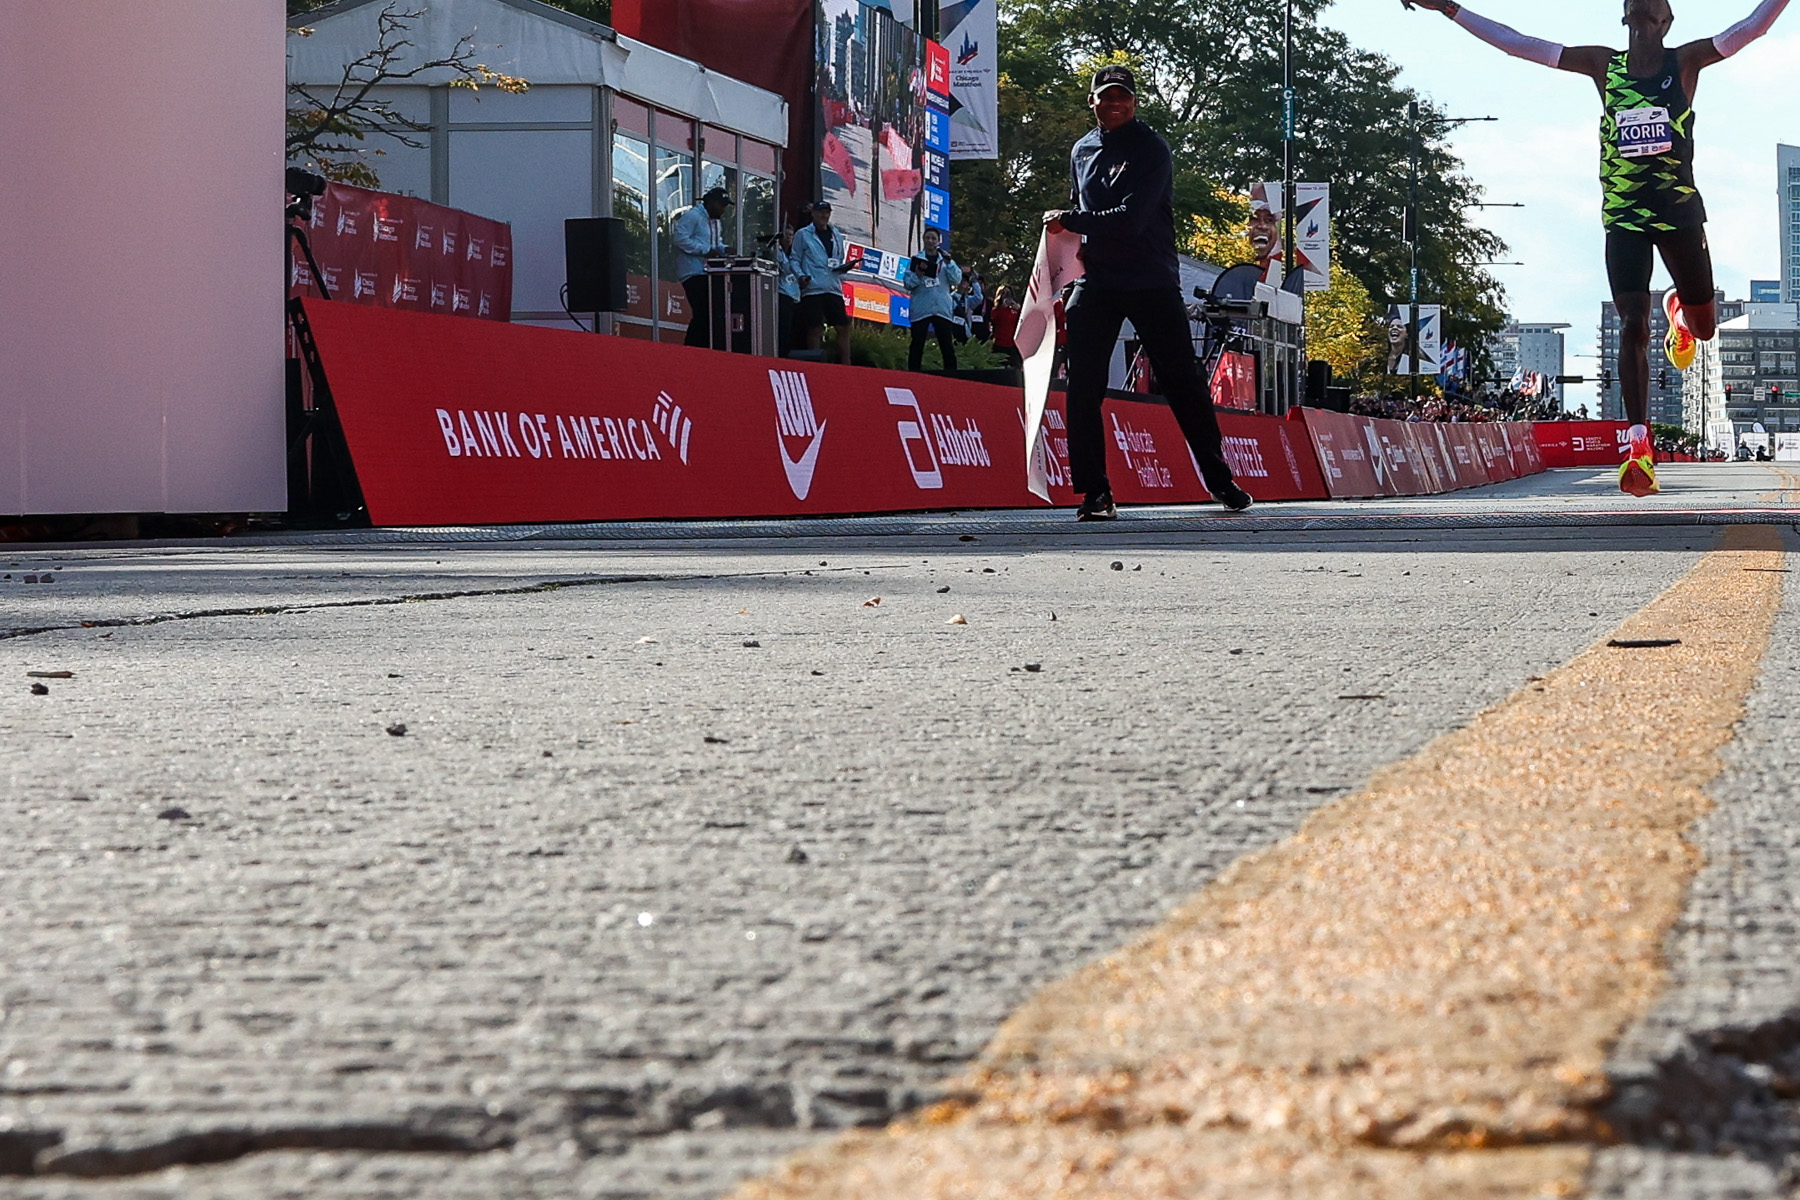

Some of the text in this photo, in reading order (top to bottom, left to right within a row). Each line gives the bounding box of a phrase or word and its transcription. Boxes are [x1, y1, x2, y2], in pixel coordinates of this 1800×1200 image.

[1621, 124, 1666, 141] KORIR
[768, 368, 819, 438] RUN
[435, 407, 662, 461] BANK OF AMERICA
[930, 412, 991, 468] Abbott
